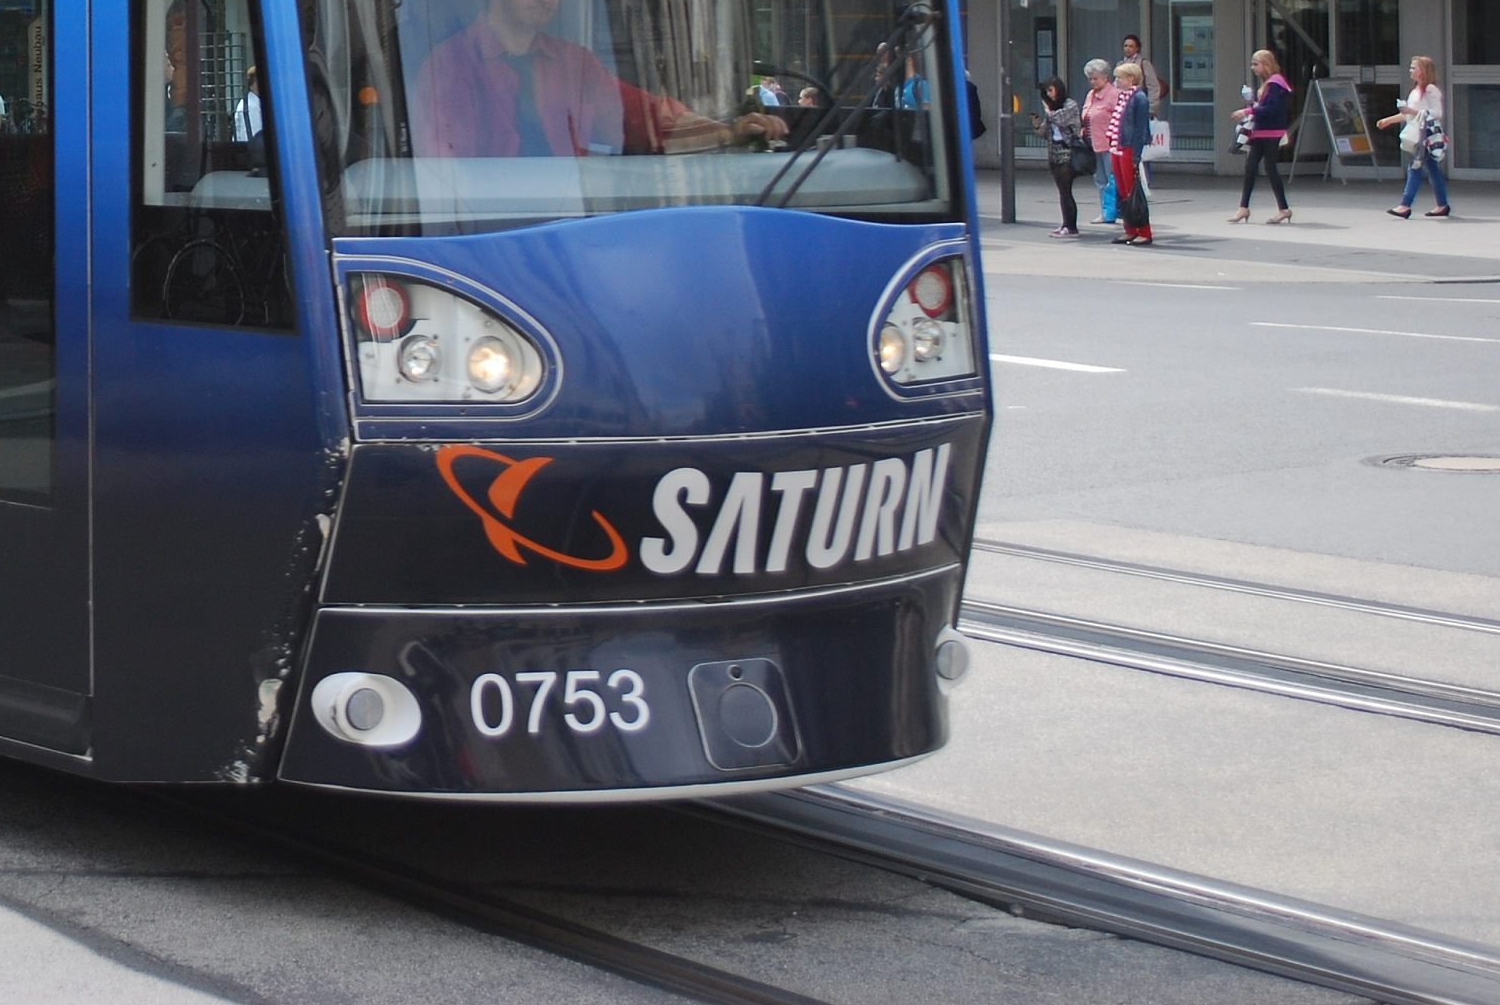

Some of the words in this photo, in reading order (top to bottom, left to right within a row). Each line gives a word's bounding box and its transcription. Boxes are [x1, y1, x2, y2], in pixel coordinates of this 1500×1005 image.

[34, 26, 43, 74] Neubau
[639, 443, 951, 575] SATURN
[470, 669, 651, 738] 0753
